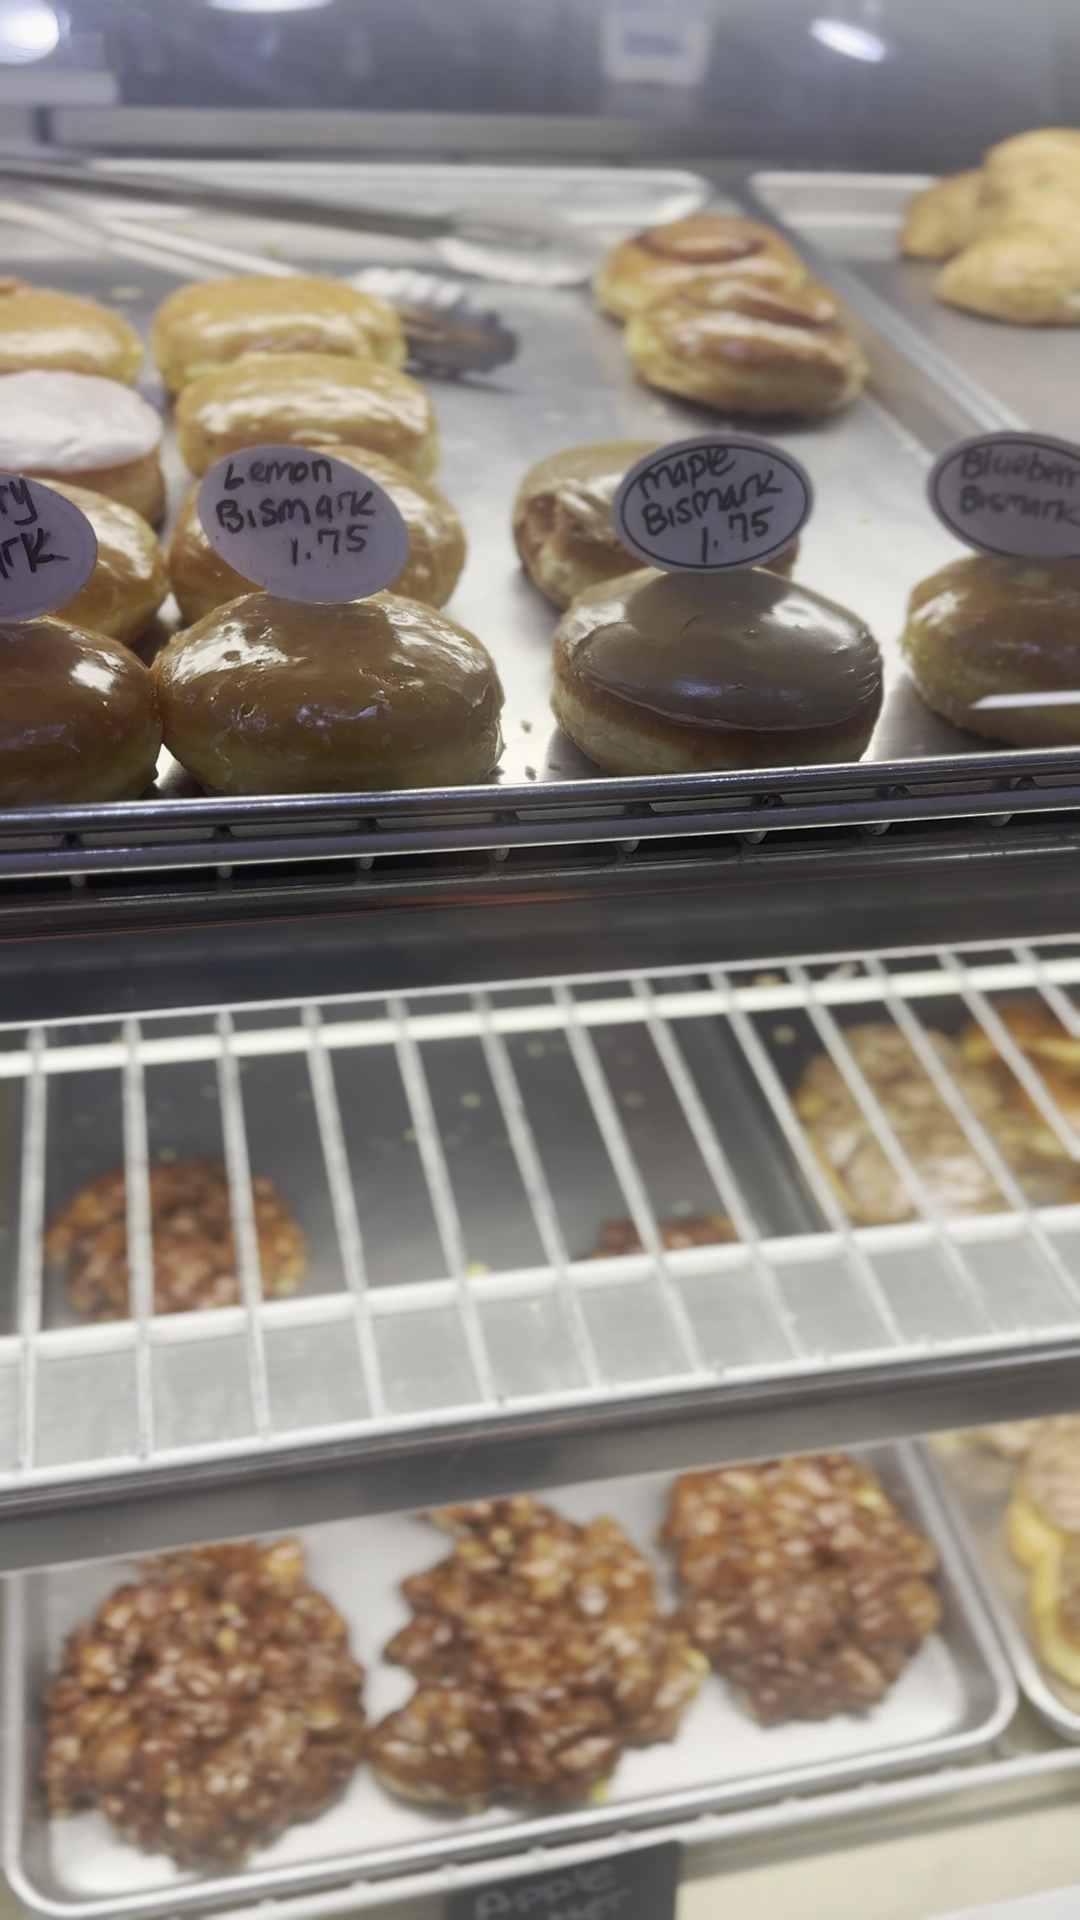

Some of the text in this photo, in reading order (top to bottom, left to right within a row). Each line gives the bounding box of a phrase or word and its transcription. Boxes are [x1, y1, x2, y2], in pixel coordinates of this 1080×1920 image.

[224, 459, 332, 490] Lemon
[290, 524, 368, 566] 1.75
[702, 506, 774, 563] 1.75
